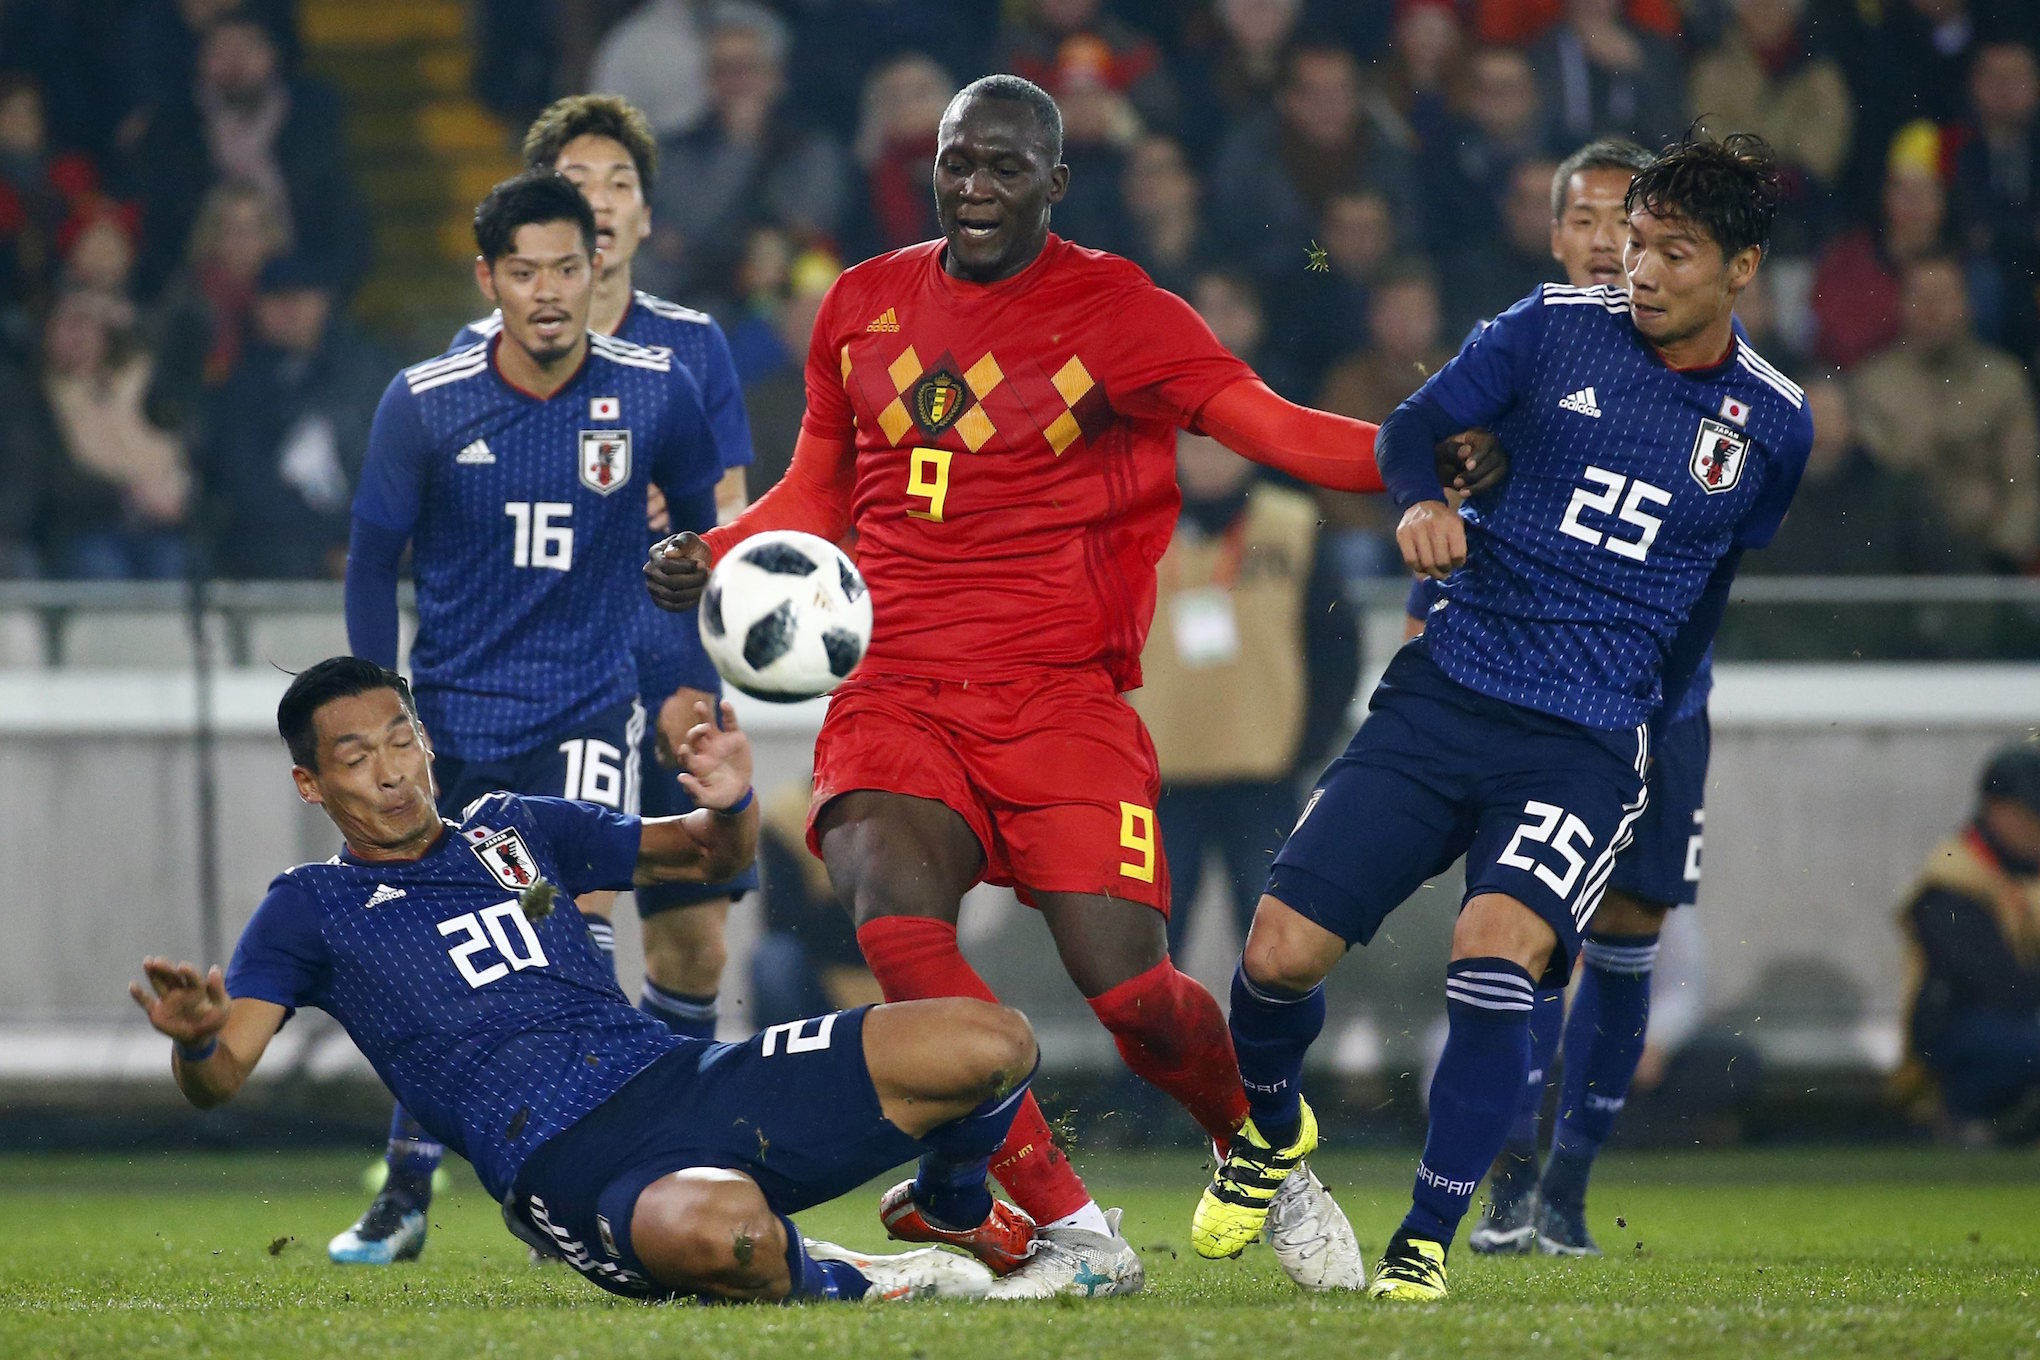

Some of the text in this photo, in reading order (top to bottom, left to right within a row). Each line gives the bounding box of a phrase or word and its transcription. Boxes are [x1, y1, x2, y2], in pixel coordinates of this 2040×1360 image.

[866, 323, 900, 333] adidas
[1558, 398, 1602, 419] adidas
[1713, 425, 1740, 440] JAPAN
[906, 447, 953, 523] 9
[1559, 465, 1673, 562] 25
[505, 501, 574, 572] 16
[559, 738, 621, 808] 16
[484, 833, 508, 848] JAPAN
[1119, 800, 1155, 883] 9
[1496, 800, 1594, 900] 25
[436, 899, 550, 989] 20
[1417, 1160, 1476, 1196] JAPAN
